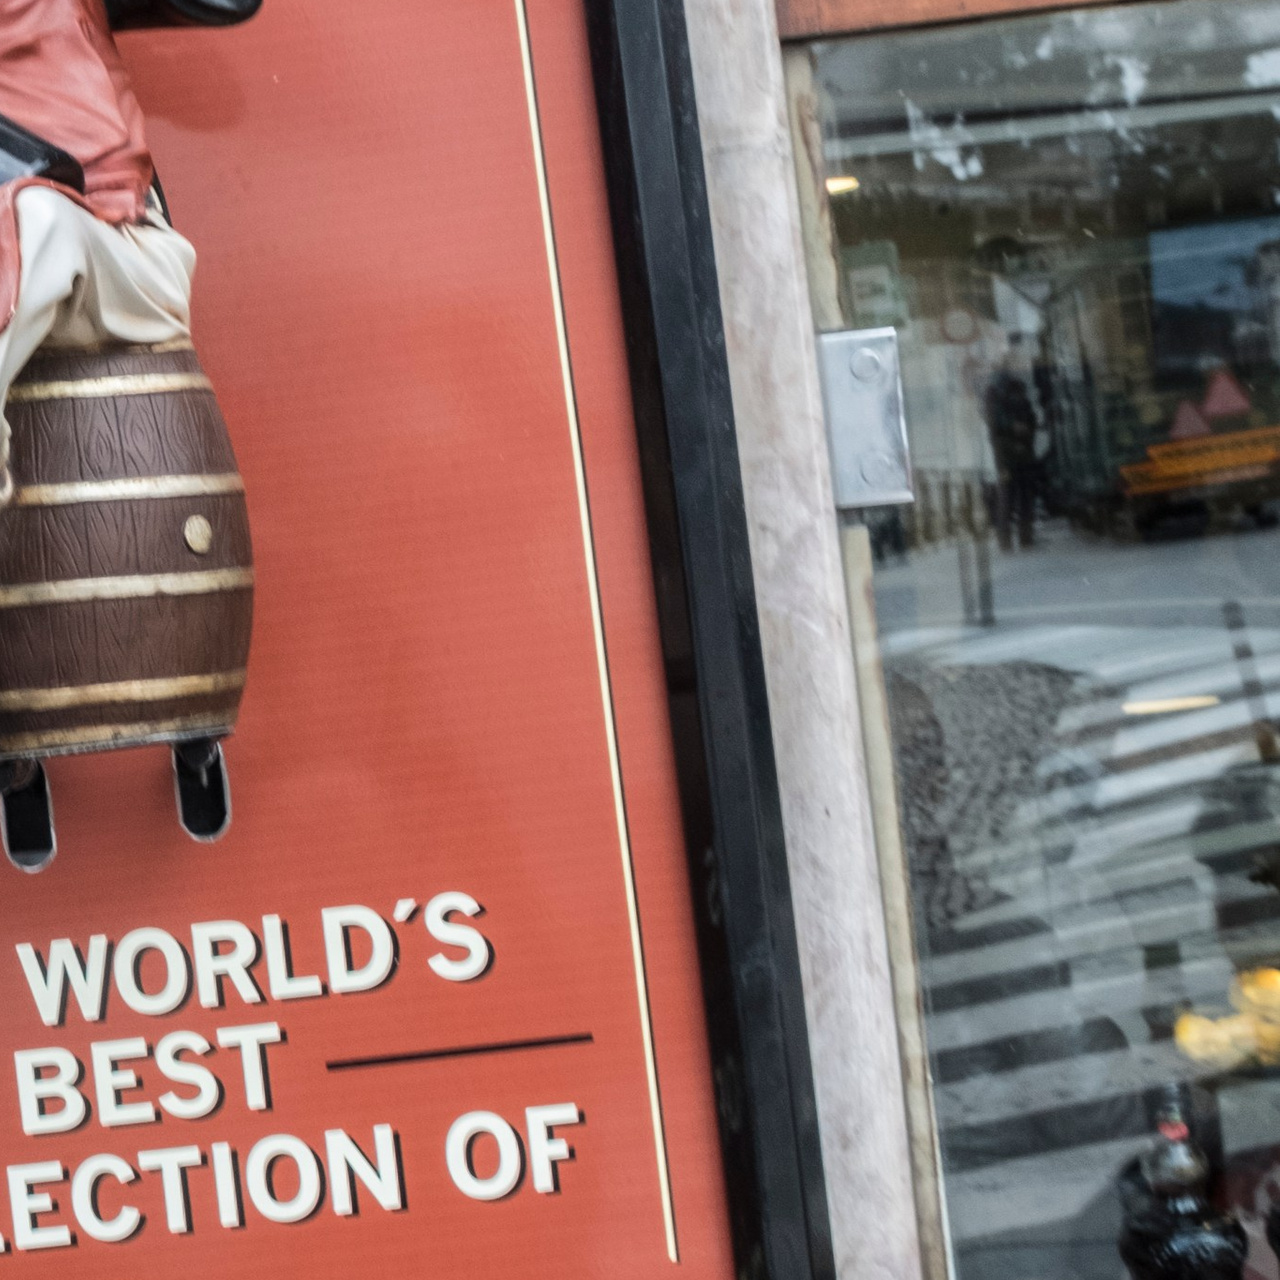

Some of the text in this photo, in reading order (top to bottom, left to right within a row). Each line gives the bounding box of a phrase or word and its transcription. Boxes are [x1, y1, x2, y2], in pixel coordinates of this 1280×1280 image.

[15, 890, 494, 1026] WORLD'S
[14, 1021, 284, 1135] BEST
[445, 1102, 581, 1200] OF
